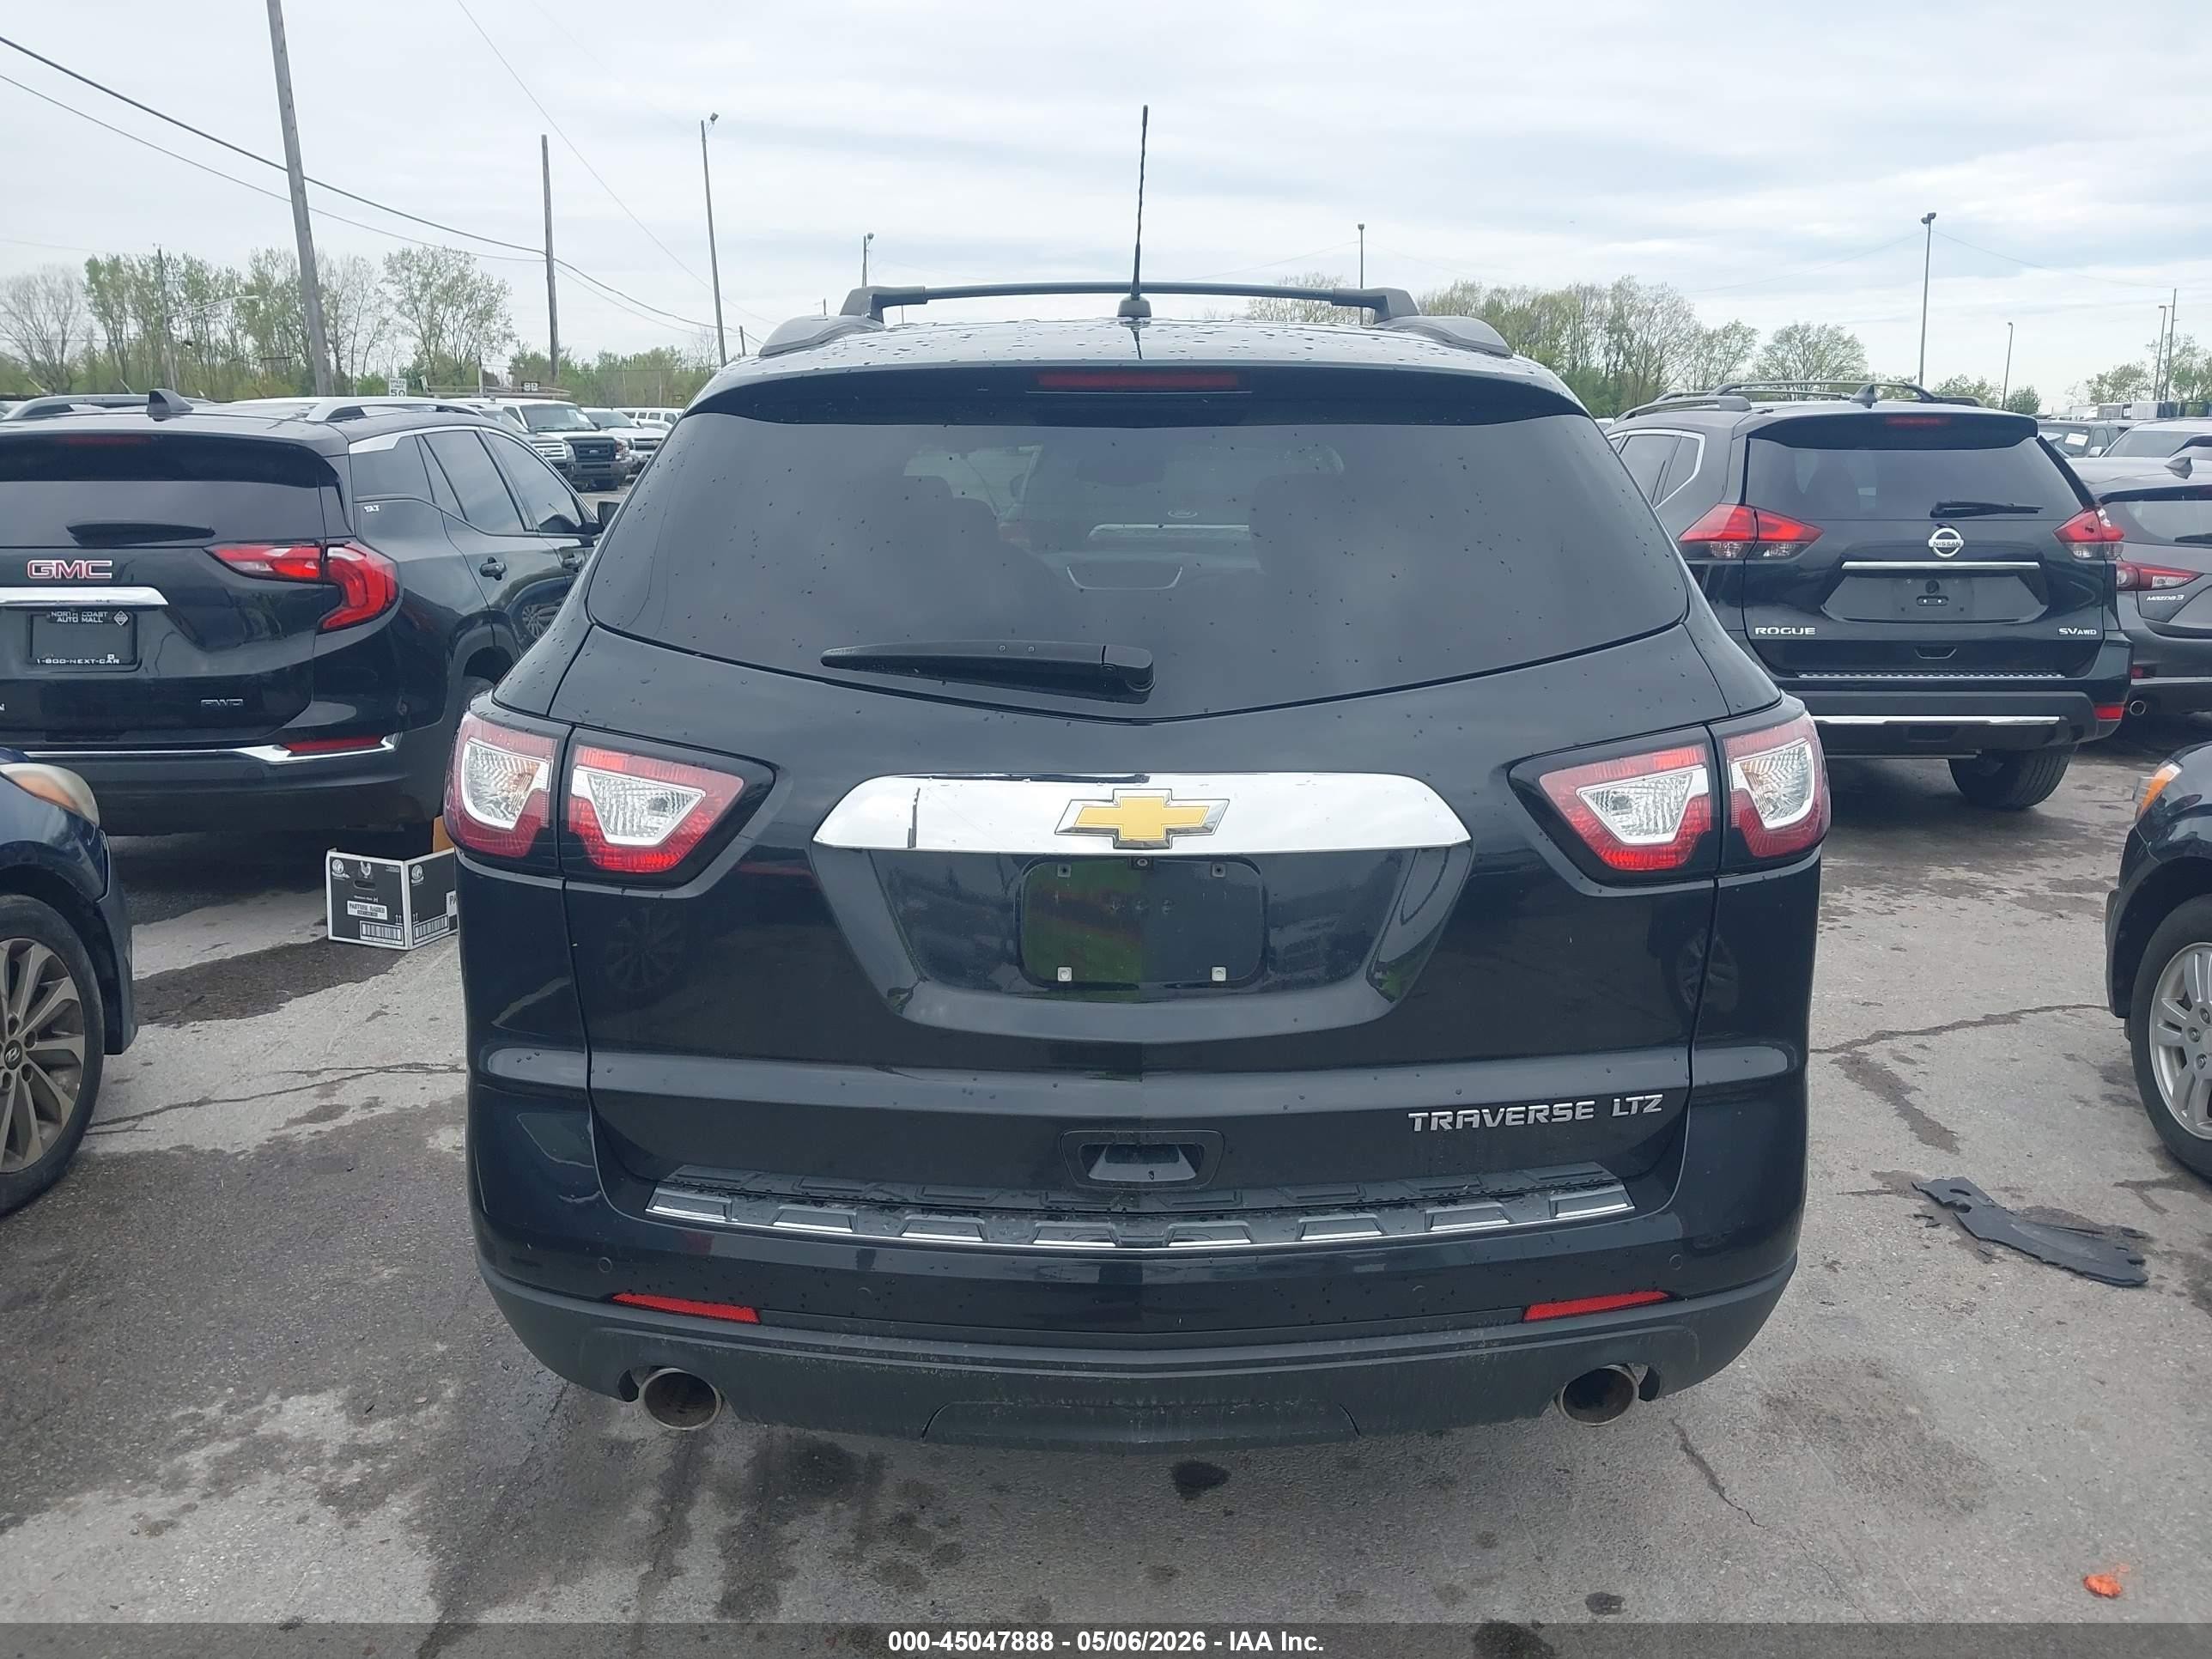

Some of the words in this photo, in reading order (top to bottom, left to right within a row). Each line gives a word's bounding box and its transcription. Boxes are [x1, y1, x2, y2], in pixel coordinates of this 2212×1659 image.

[27, 560, 112, 579] GMC
[1408, 1101, 1595, 1132] TRAVERSE
[1612, 1094, 1663, 1116] LTZ
